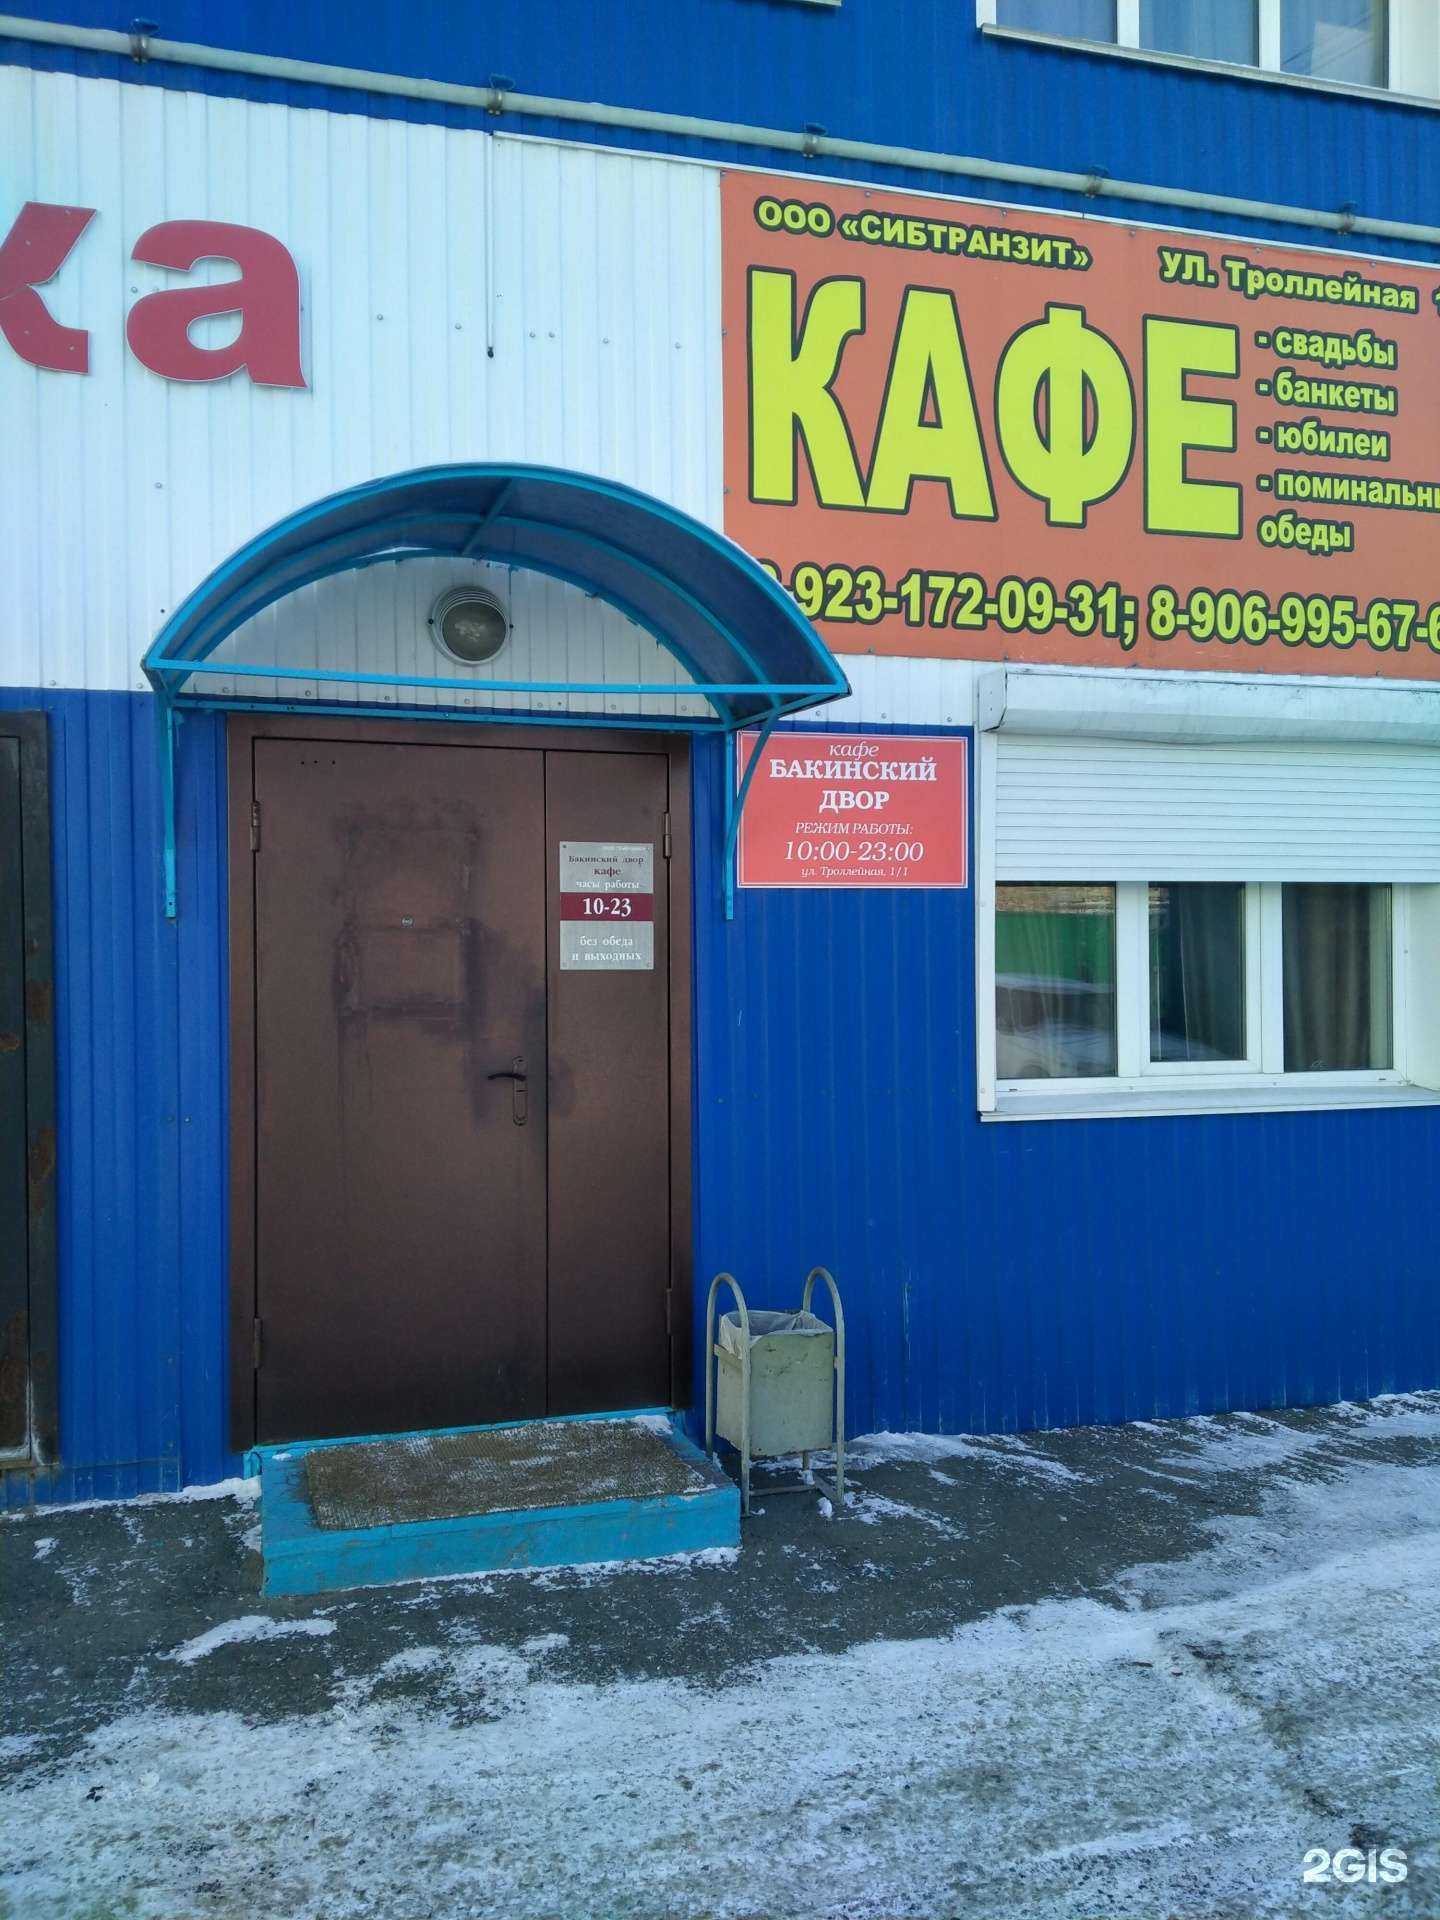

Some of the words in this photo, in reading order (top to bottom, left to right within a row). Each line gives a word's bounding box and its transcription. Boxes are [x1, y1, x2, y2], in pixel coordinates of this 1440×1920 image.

[757, 199, 832, 234] ООО
[840, 213, 1089, 267] «СИБТРАНЗИТ»
[1223, 258, 1417, 312] Троллейная
[1274, 330, 1396, 367] свадьбы
[748, 268, 1243, 538] КАФЕ
[1275, 370, 1396, 413] банкеты
[1276, 420, 1388, 458] юбилеи
[1259, 513, 1352, 552] обеды
[760, 563, 1136, 647] 923-172-09-31;
[828, 740, 880, 760] кафе
[769, 756, 937, 781] БАКИНСКИЙ
[818, 789, 890, 814] ДВОР
[795, 822, 850, 834] РЕЖИМ
[852, 823, 913, 835] РАБОТЫ:
[783, 840, 925, 862] 10:00-23:00
[592, 866, 622, 877] кафе
[576, 881, 600, 889] часы
[604, 880, 640, 891] работы
[583, 897, 632, 917] 10-23
[579, 936, 598, 946] без
[602, 936, 633, 947] обеда
[584, 952, 642, 962] выходных
